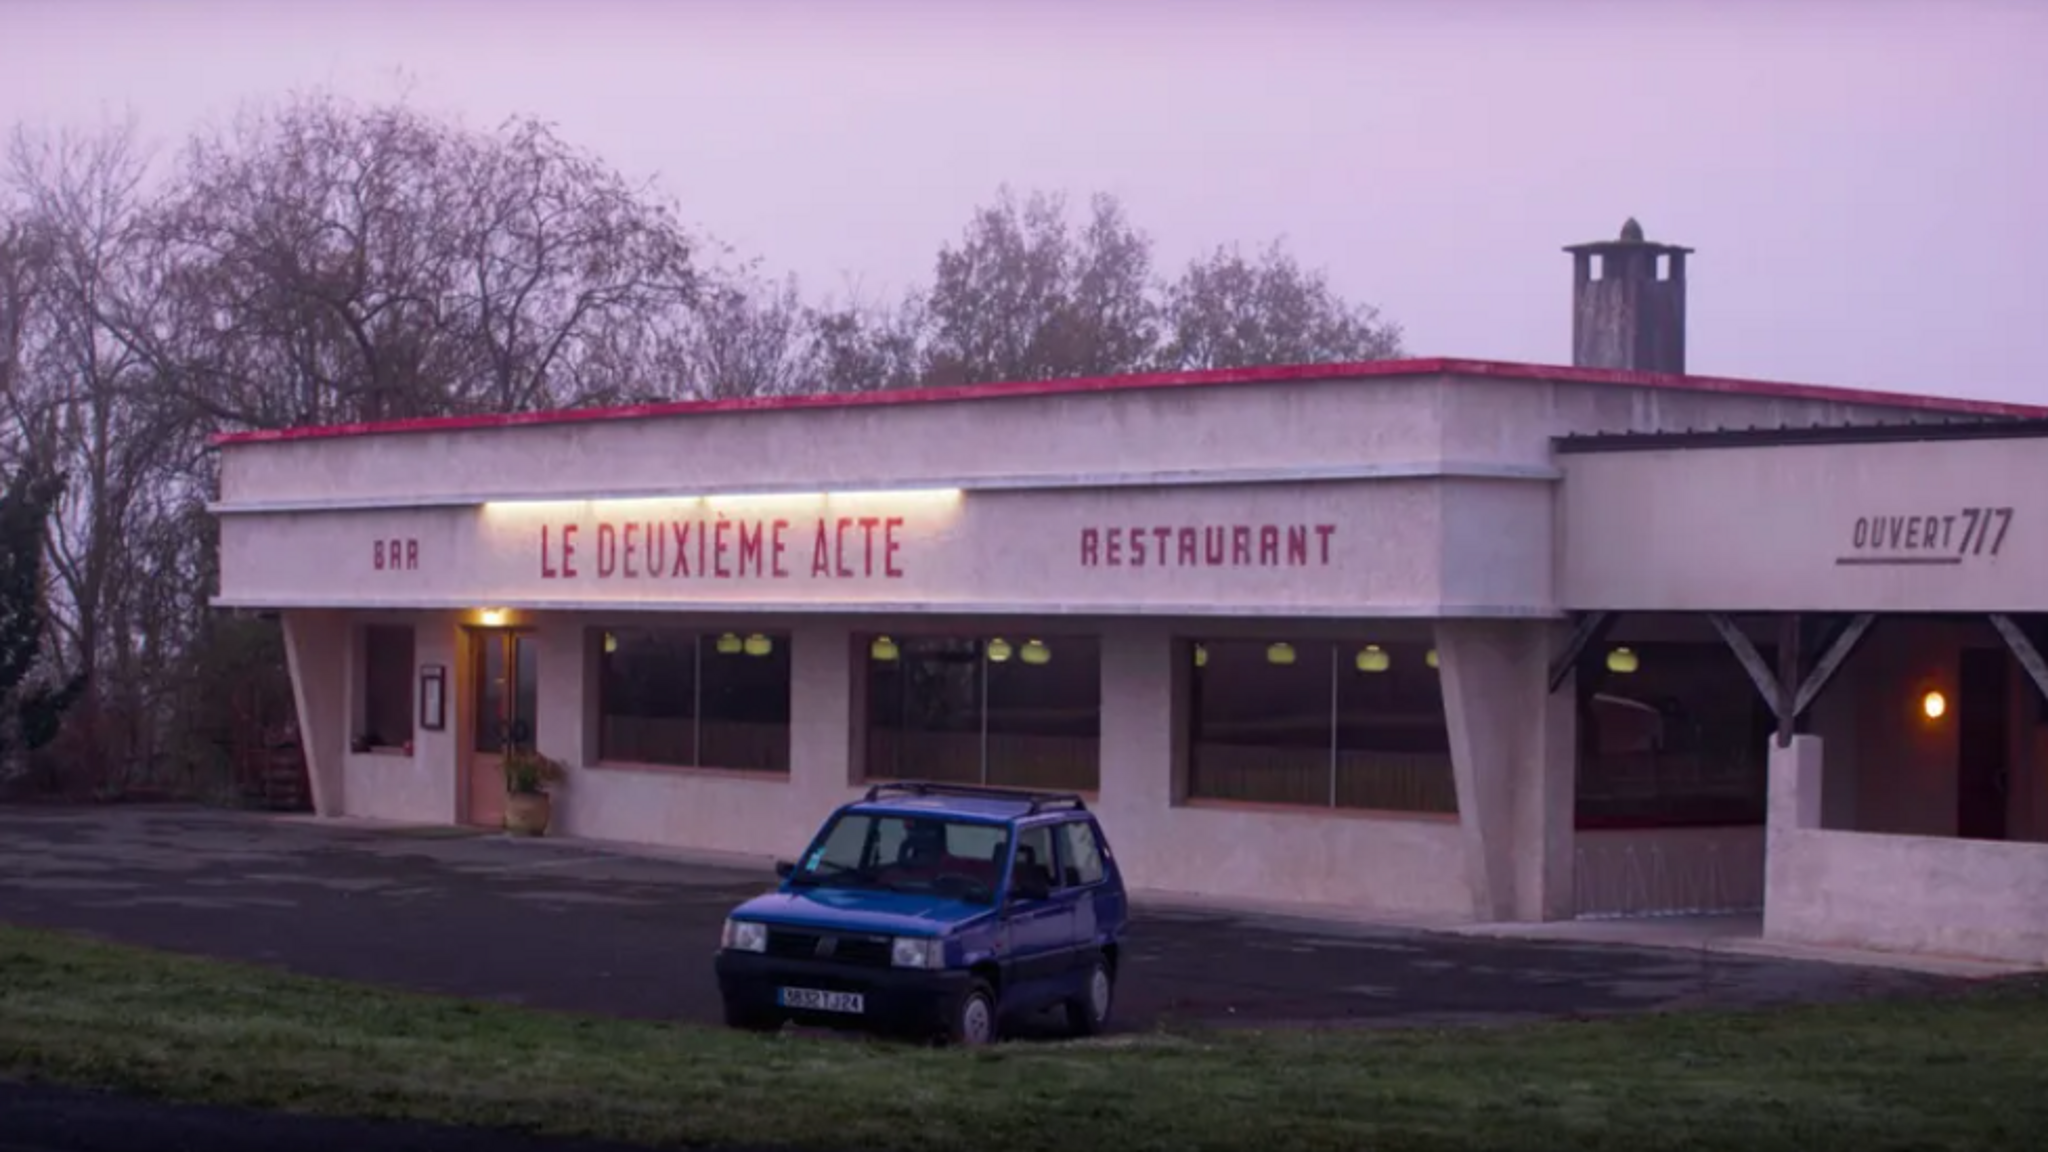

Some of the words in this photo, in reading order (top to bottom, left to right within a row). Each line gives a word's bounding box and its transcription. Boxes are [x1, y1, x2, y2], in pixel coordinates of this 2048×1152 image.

[541, 524, 578, 578] LE
[597, 511, 789, 578] DEUXIÈME
[811, 517, 904, 578] ACTE
[1081, 524, 1337, 567] RESTAURANT
[1852, 515, 1956, 549] OUVERT
[1957, 506, 2015, 555] 7/7
[374, 539, 418, 570] BAR
